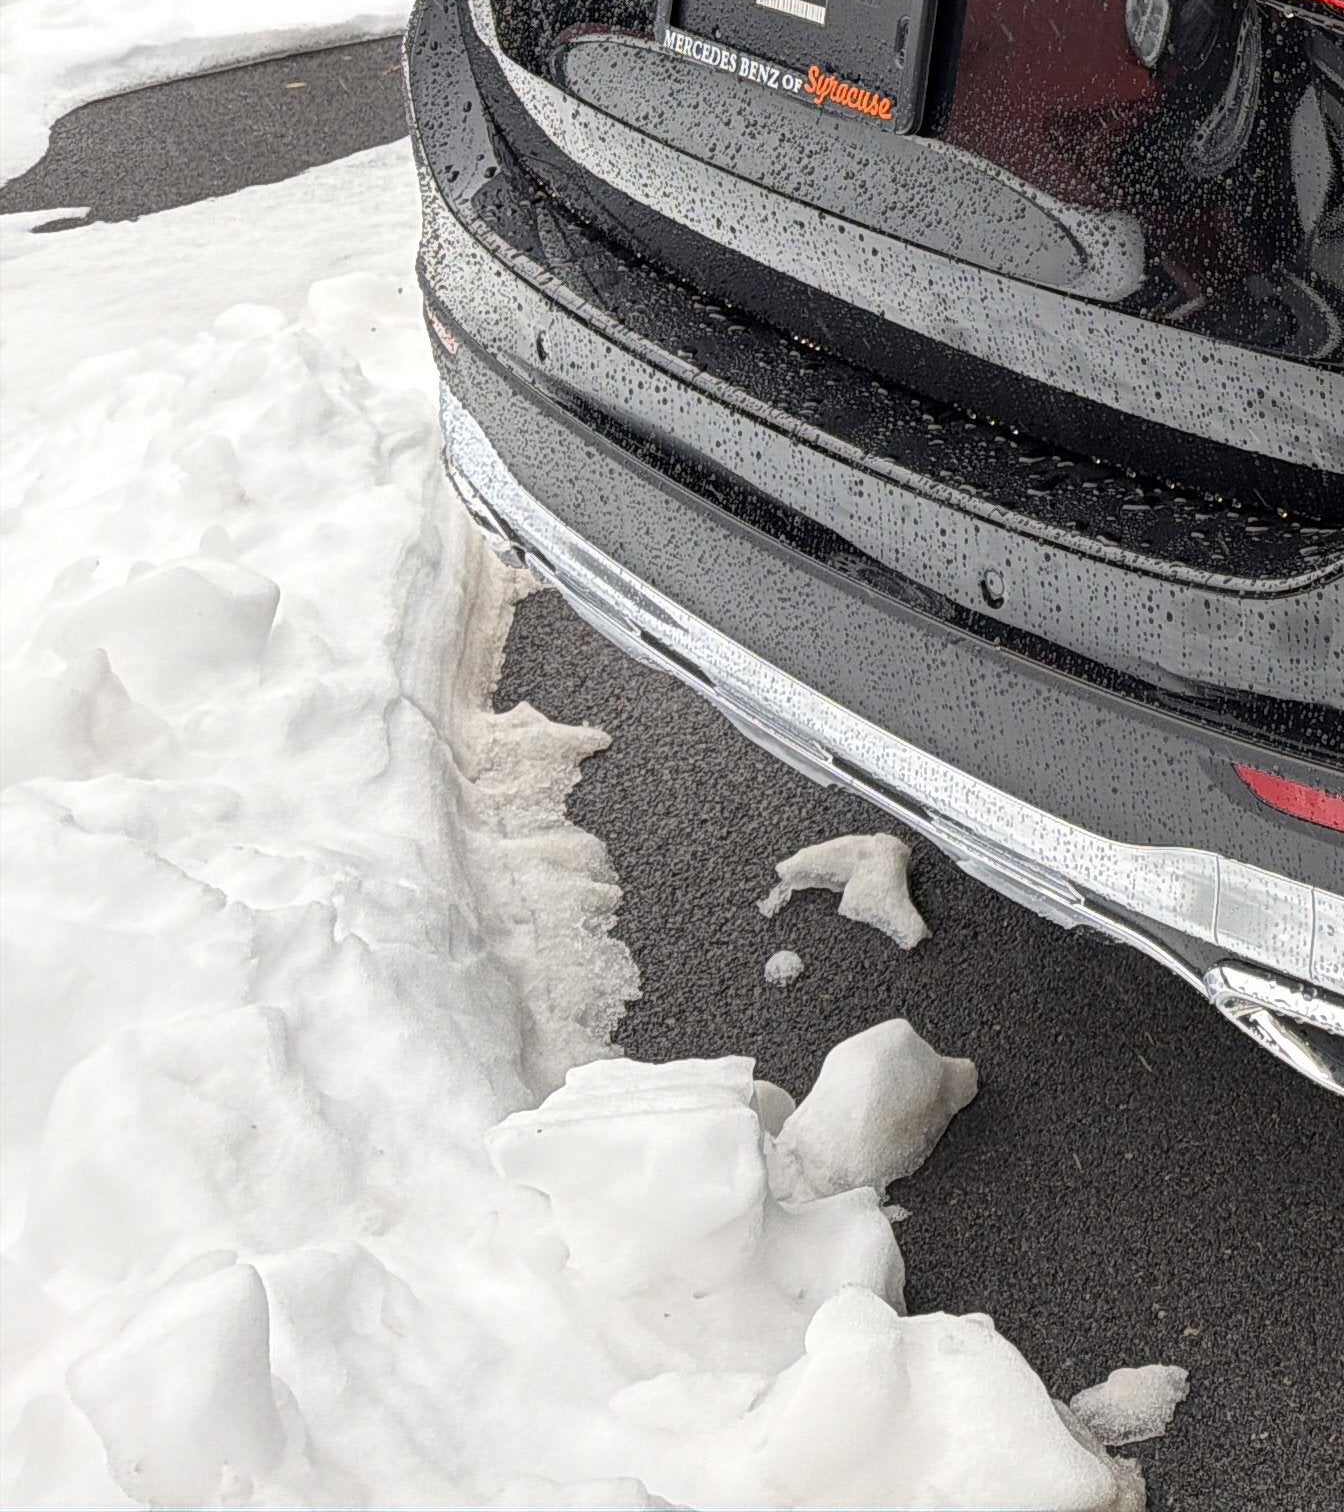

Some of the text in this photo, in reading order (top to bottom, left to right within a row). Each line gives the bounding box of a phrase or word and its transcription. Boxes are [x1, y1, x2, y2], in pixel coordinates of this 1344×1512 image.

[663, 29, 893, 120] MERCEDES BENZ OF Syracuse
